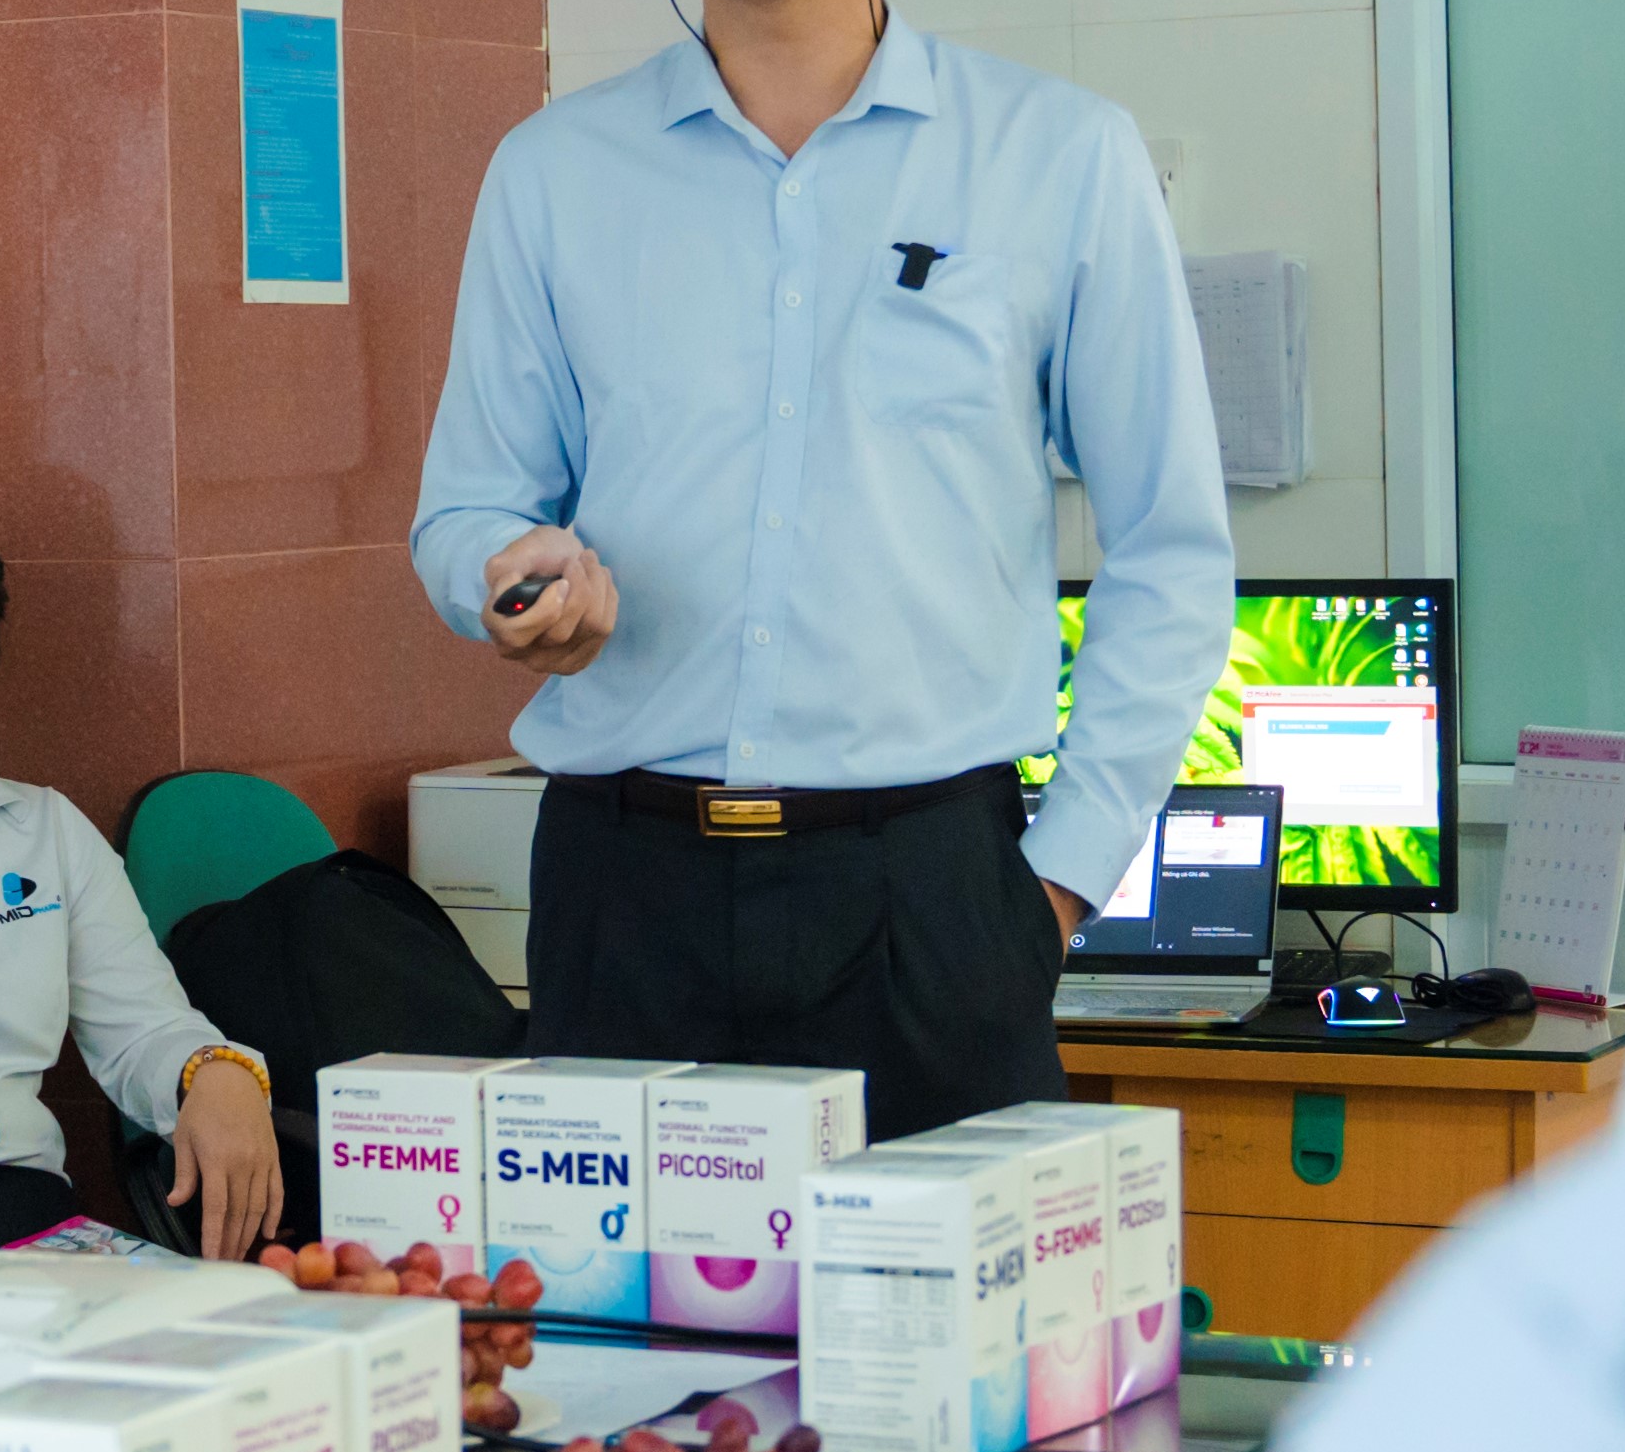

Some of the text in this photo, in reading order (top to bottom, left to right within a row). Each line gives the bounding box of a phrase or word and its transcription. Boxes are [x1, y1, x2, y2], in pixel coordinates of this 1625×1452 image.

[332, 1109, 455, 1124] FEMALE FERTILITY AND
[333, 1141, 460, 1174] S-FEMME
[498, 1148, 629, 1186] S-MEN
[658, 1153, 764, 1181] PiCOSitol
[1035, 1216, 1102, 1263] S-FEMME
